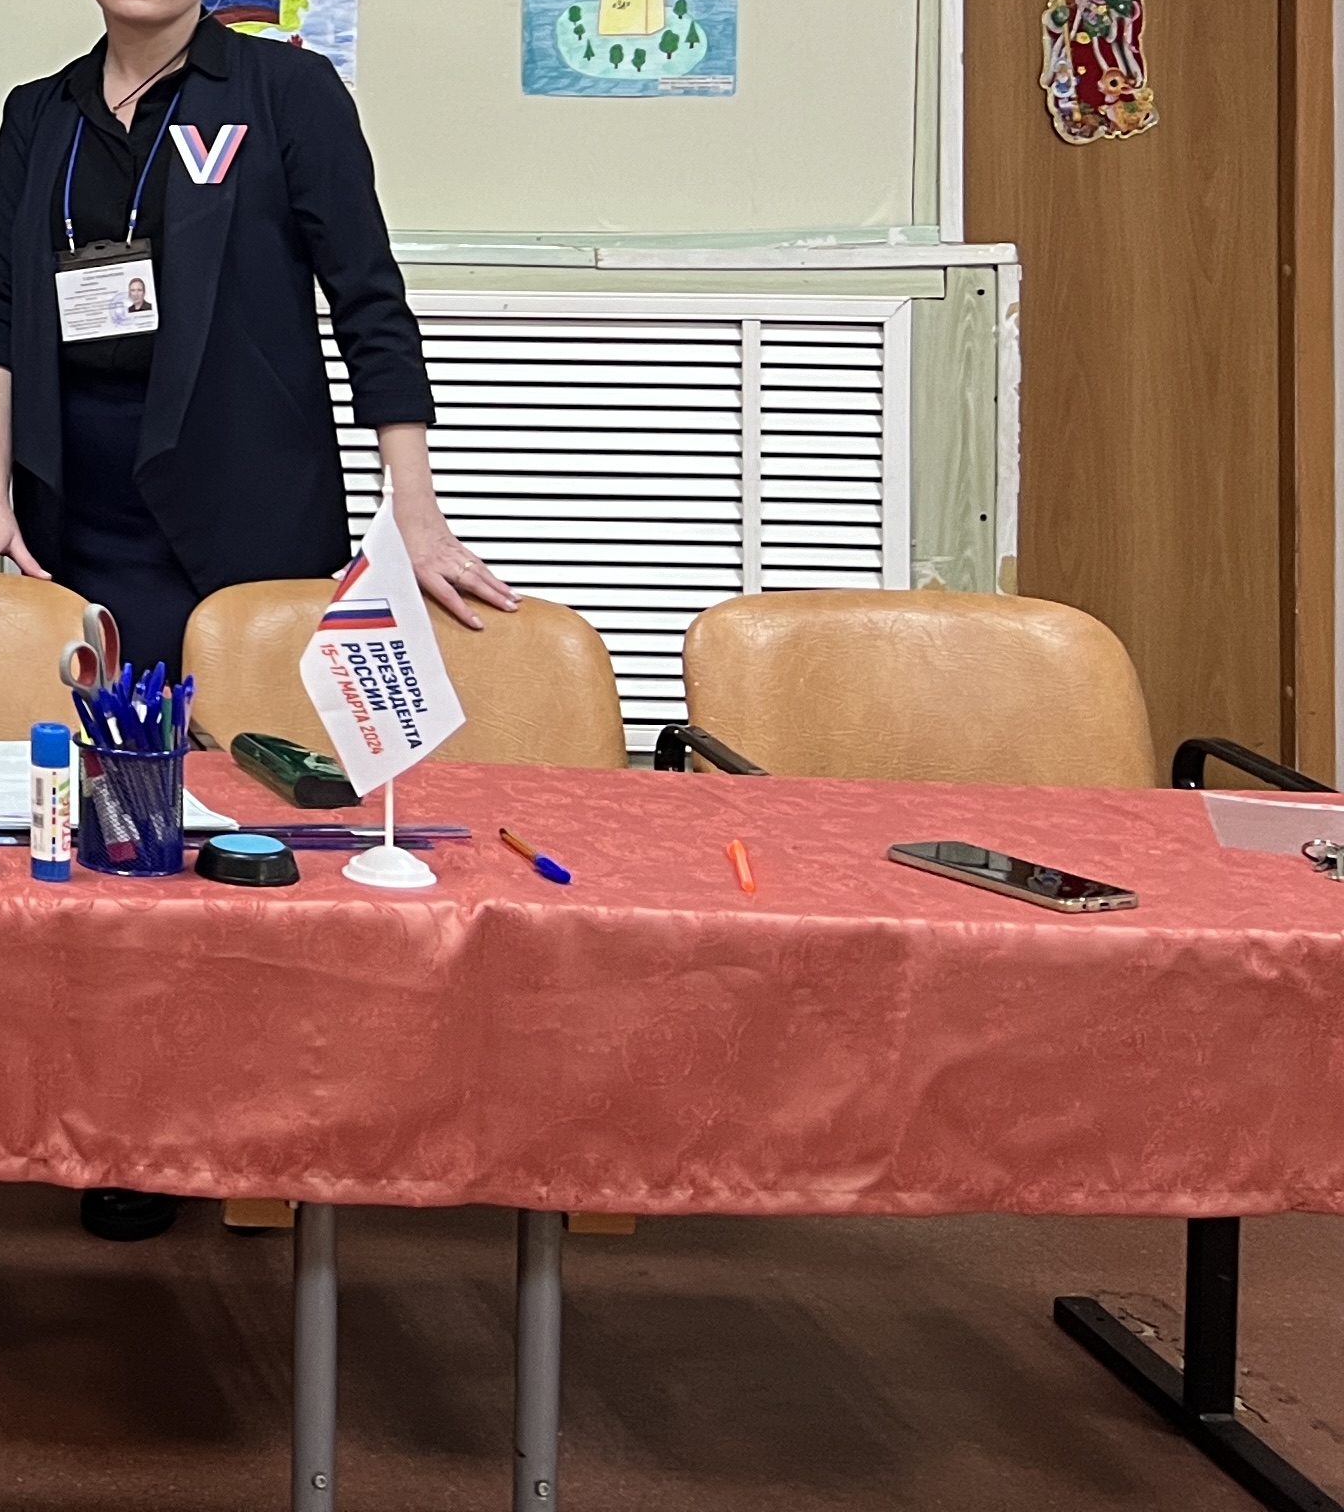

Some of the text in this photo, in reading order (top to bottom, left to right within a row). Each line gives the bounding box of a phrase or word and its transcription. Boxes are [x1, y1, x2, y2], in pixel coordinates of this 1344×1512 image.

[340, 642, 389, 711] РОССИИ
[366, 641, 423, 749] ПРЕЗИДЕНТА
[389, 639, 428, 713] ВЫБОРЫ
[337, 681, 370, 723] МАРТА
[359, 725, 384, 755] 2024
